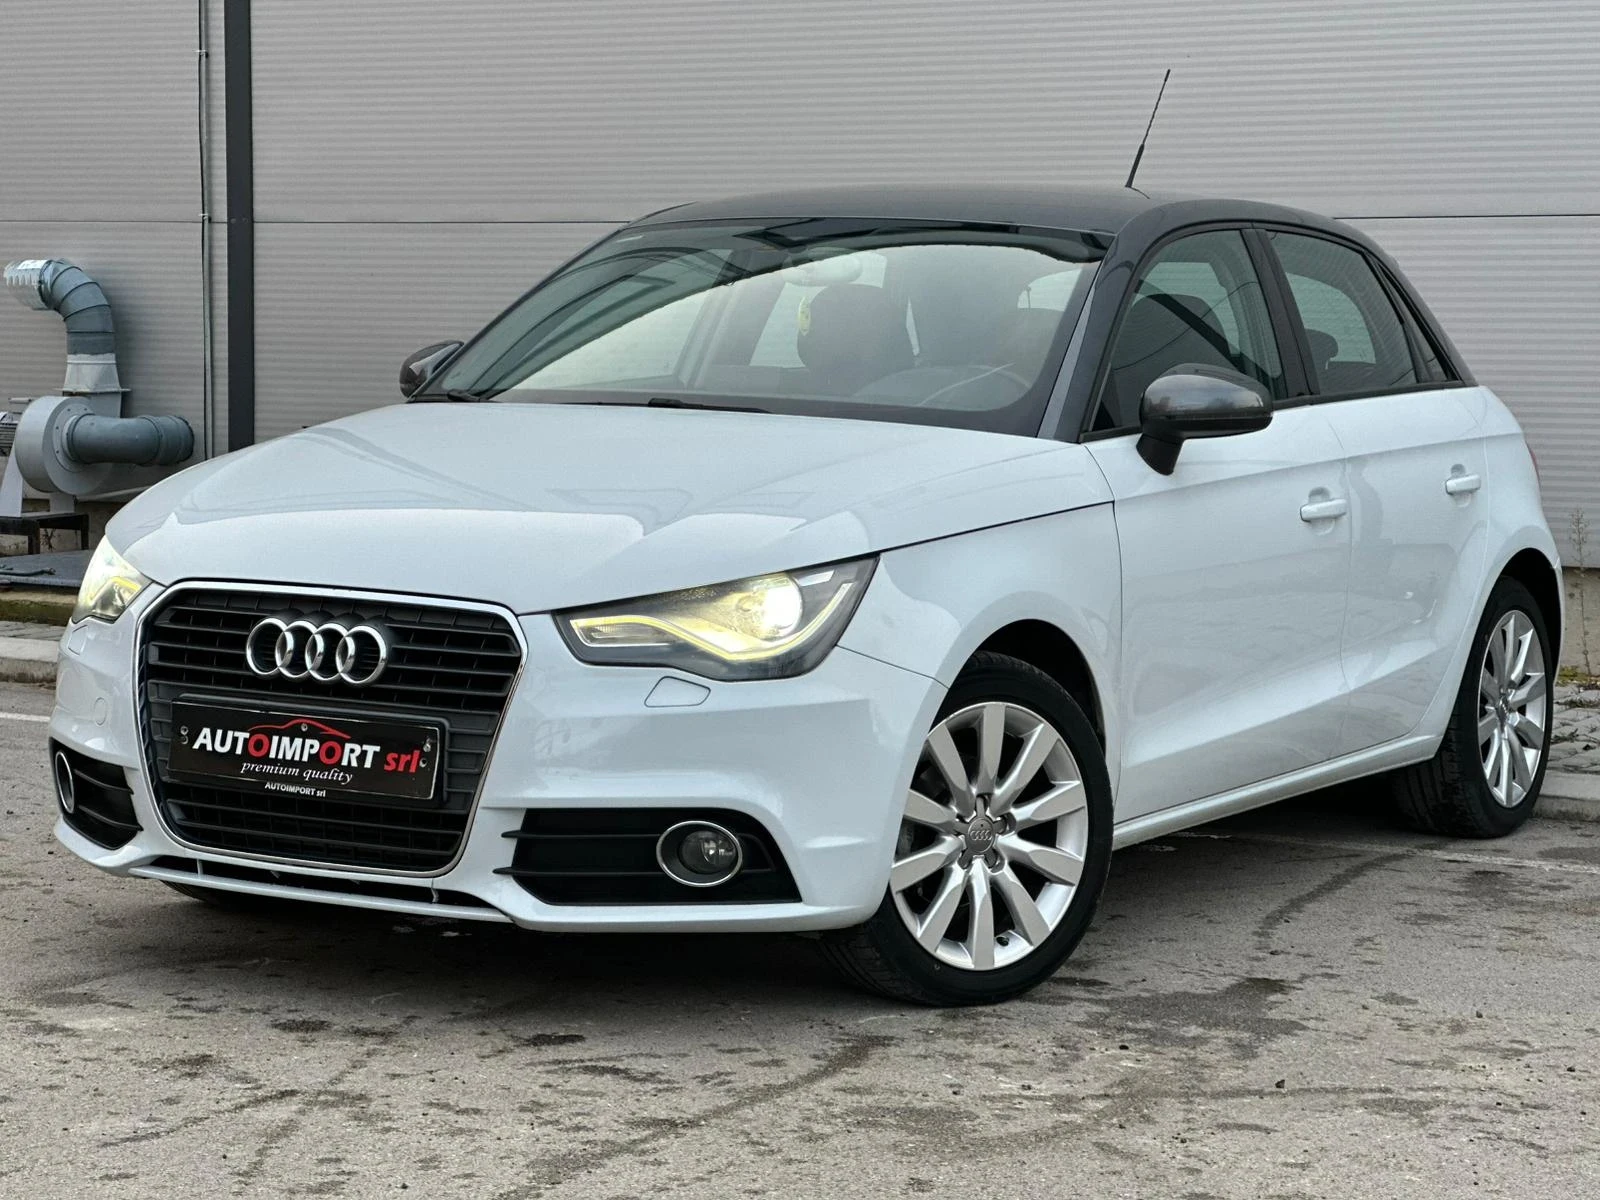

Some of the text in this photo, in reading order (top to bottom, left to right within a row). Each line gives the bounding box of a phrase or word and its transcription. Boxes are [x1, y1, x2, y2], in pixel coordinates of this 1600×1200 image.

[193, 727, 420, 772] AUTOIMPORT srl
[240, 762, 353, 785] premium quality
[264, 782, 326, 797] AUTOIMPORT srl
